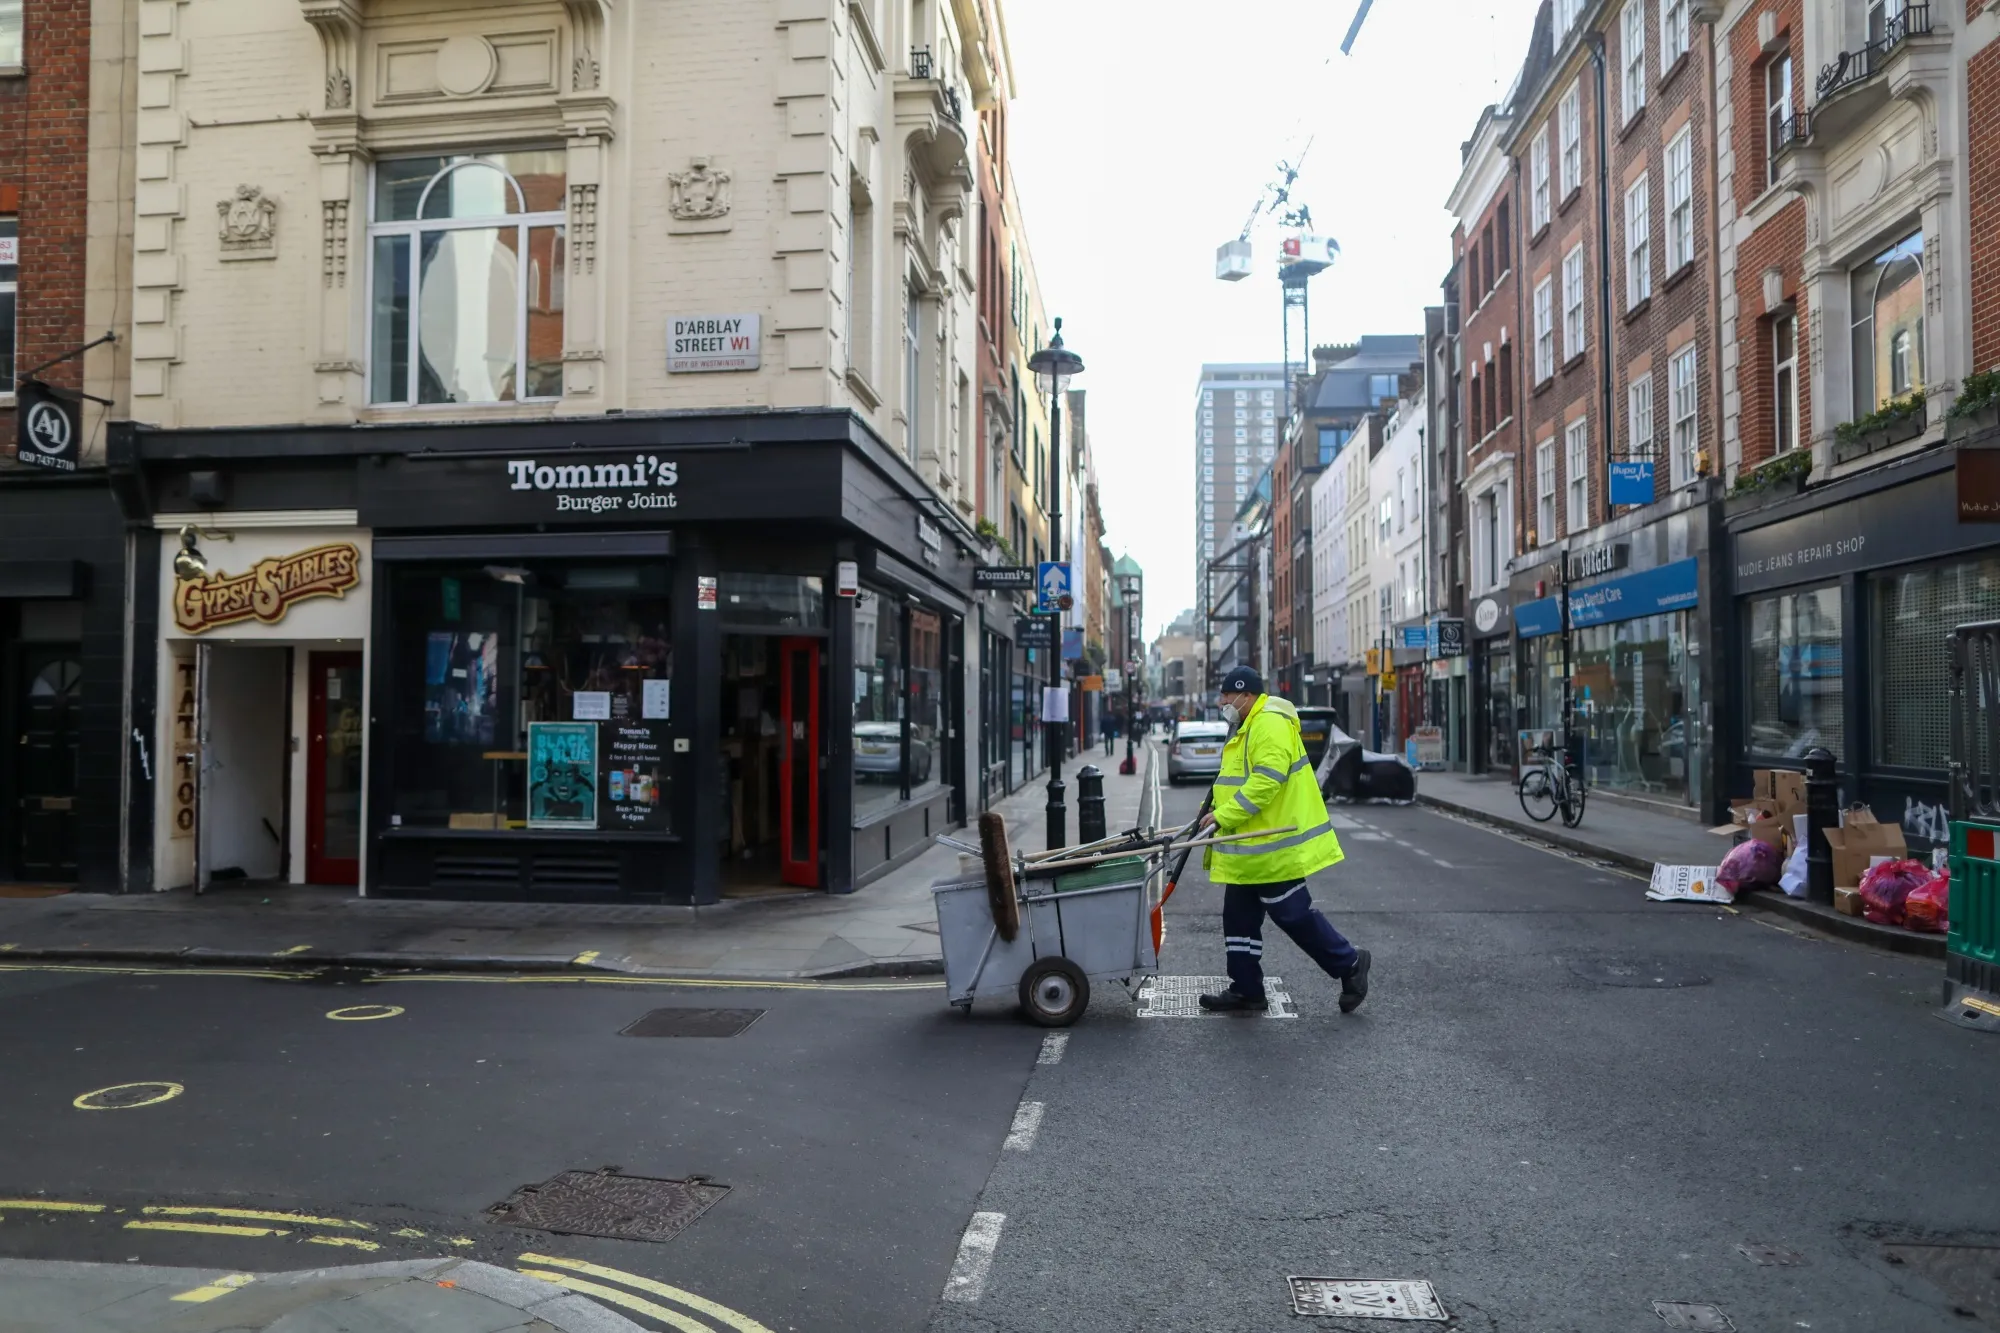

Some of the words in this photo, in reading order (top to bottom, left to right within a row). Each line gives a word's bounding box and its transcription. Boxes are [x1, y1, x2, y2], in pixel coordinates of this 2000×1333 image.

[675, 319, 741, 335] D'ARBLAY
[675, 337, 725, 352] STREET
[730, 336, 750, 350] W1
[690, 360, 698, 368] OF
[700, 359, 745, 367] WESTMINSTER
[19, 450, 35, 463] 020
[507, 455, 678, 489] Tommi's
[1612, 465, 1637, 476] Bupa
[556, 494, 622, 513] Burger
[627, 492, 677, 509] Joint
[1738, 560, 1763, 577] NUDIE
[1765, 552, 1793, 571] JEANS
[1797, 544, 1832, 565] REPAIR
[1836, 535, 1865, 556] SHOP
[976, 570, 1031, 580] Tommi's
[174, 575, 255, 627] GYPSY
[252, 550, 352, 617] STABLES
[1568, 595, 1585, 611] Bupa
[1584, 590, 1605, 608] Dental
[1605, 587, 1622, 604] Care
[536, 734, 589, 749] BLACK
[613, 742, 636, 751] Happy
[638, 742, 658, 750] Hour
[551, 744, 591, 764] BLUE
[634, 805, 651, 813] Thur
[1676, 867, 1689, 893] 41103
